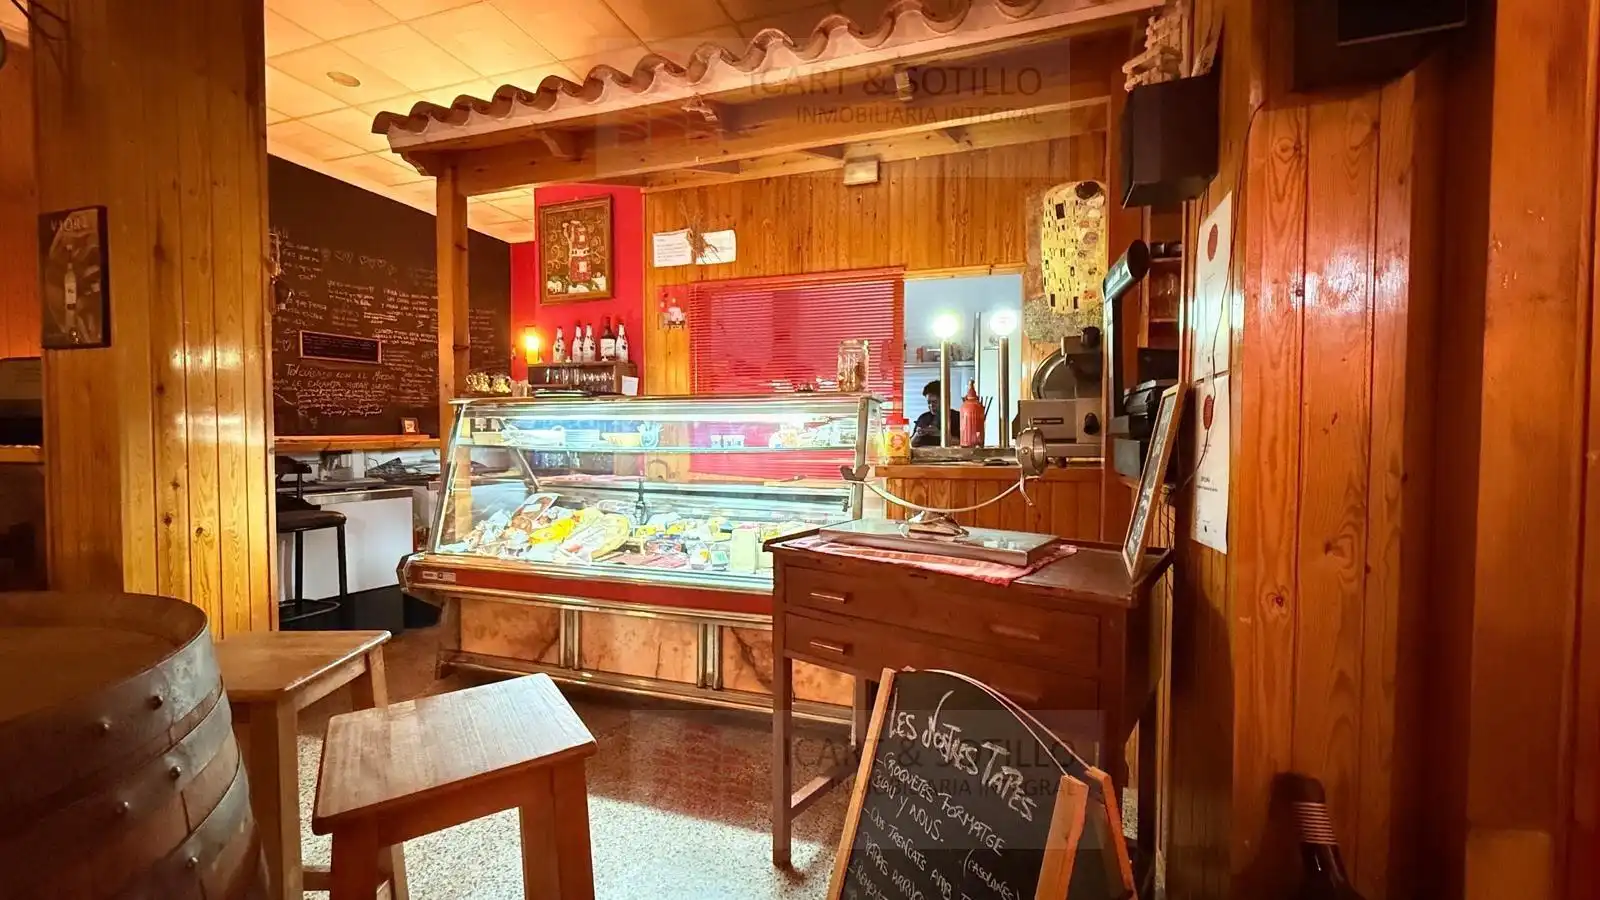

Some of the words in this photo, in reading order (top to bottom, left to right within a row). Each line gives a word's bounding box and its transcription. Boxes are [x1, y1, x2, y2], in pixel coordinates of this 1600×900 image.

[888, 687, 917, 741] LES
[922, 690, 978, 776] NOSTRES
[981, 741, 1037, 822] TAPES
[895, 796, 909, 818] Y
[937, 792, 1006, 857] FORMATGE
[888, 824, 927, 871] TRENCATS
